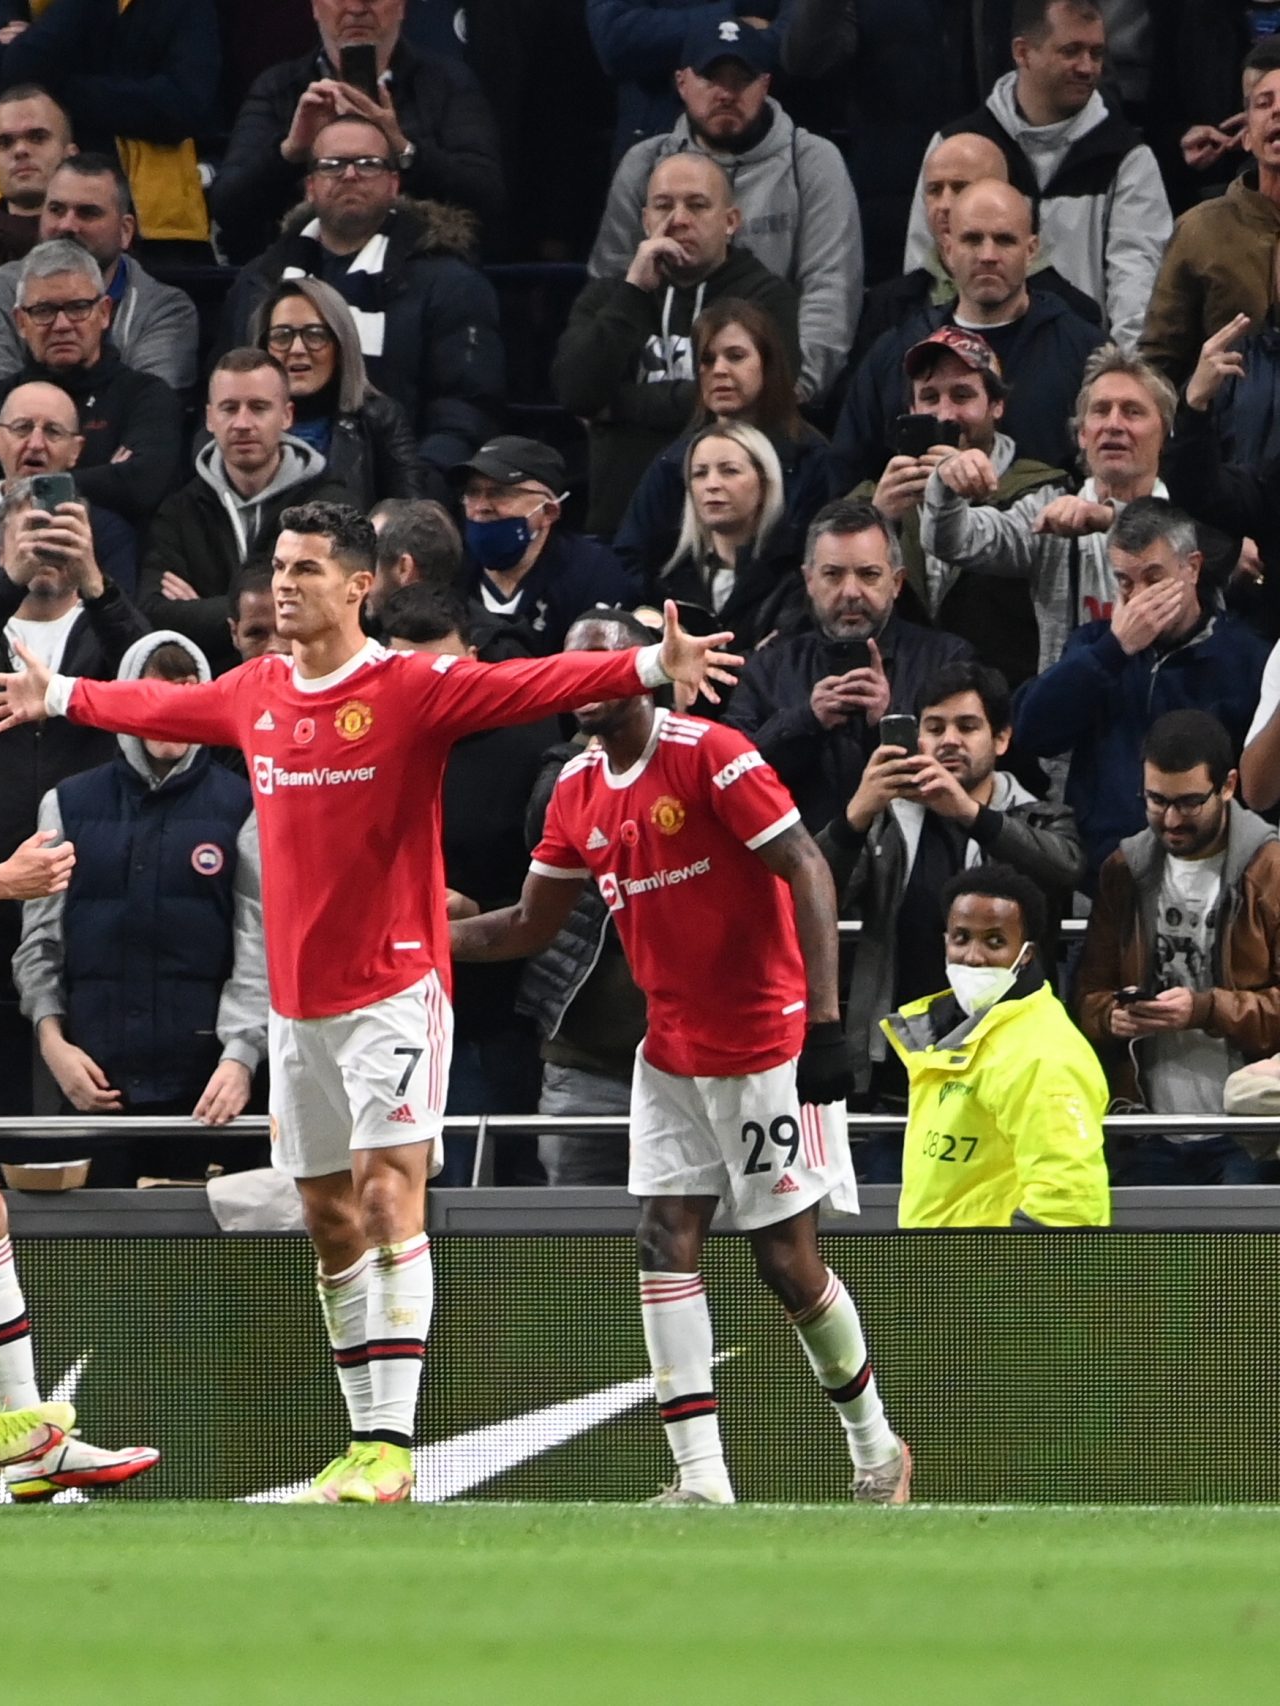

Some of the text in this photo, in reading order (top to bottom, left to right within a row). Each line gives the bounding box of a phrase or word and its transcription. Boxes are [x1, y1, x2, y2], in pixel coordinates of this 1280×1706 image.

[273, 766, 376, 786] TeamViewer
[394, 1047, 424, 1097] 7
[741, 1114, 800, 1175] 29
